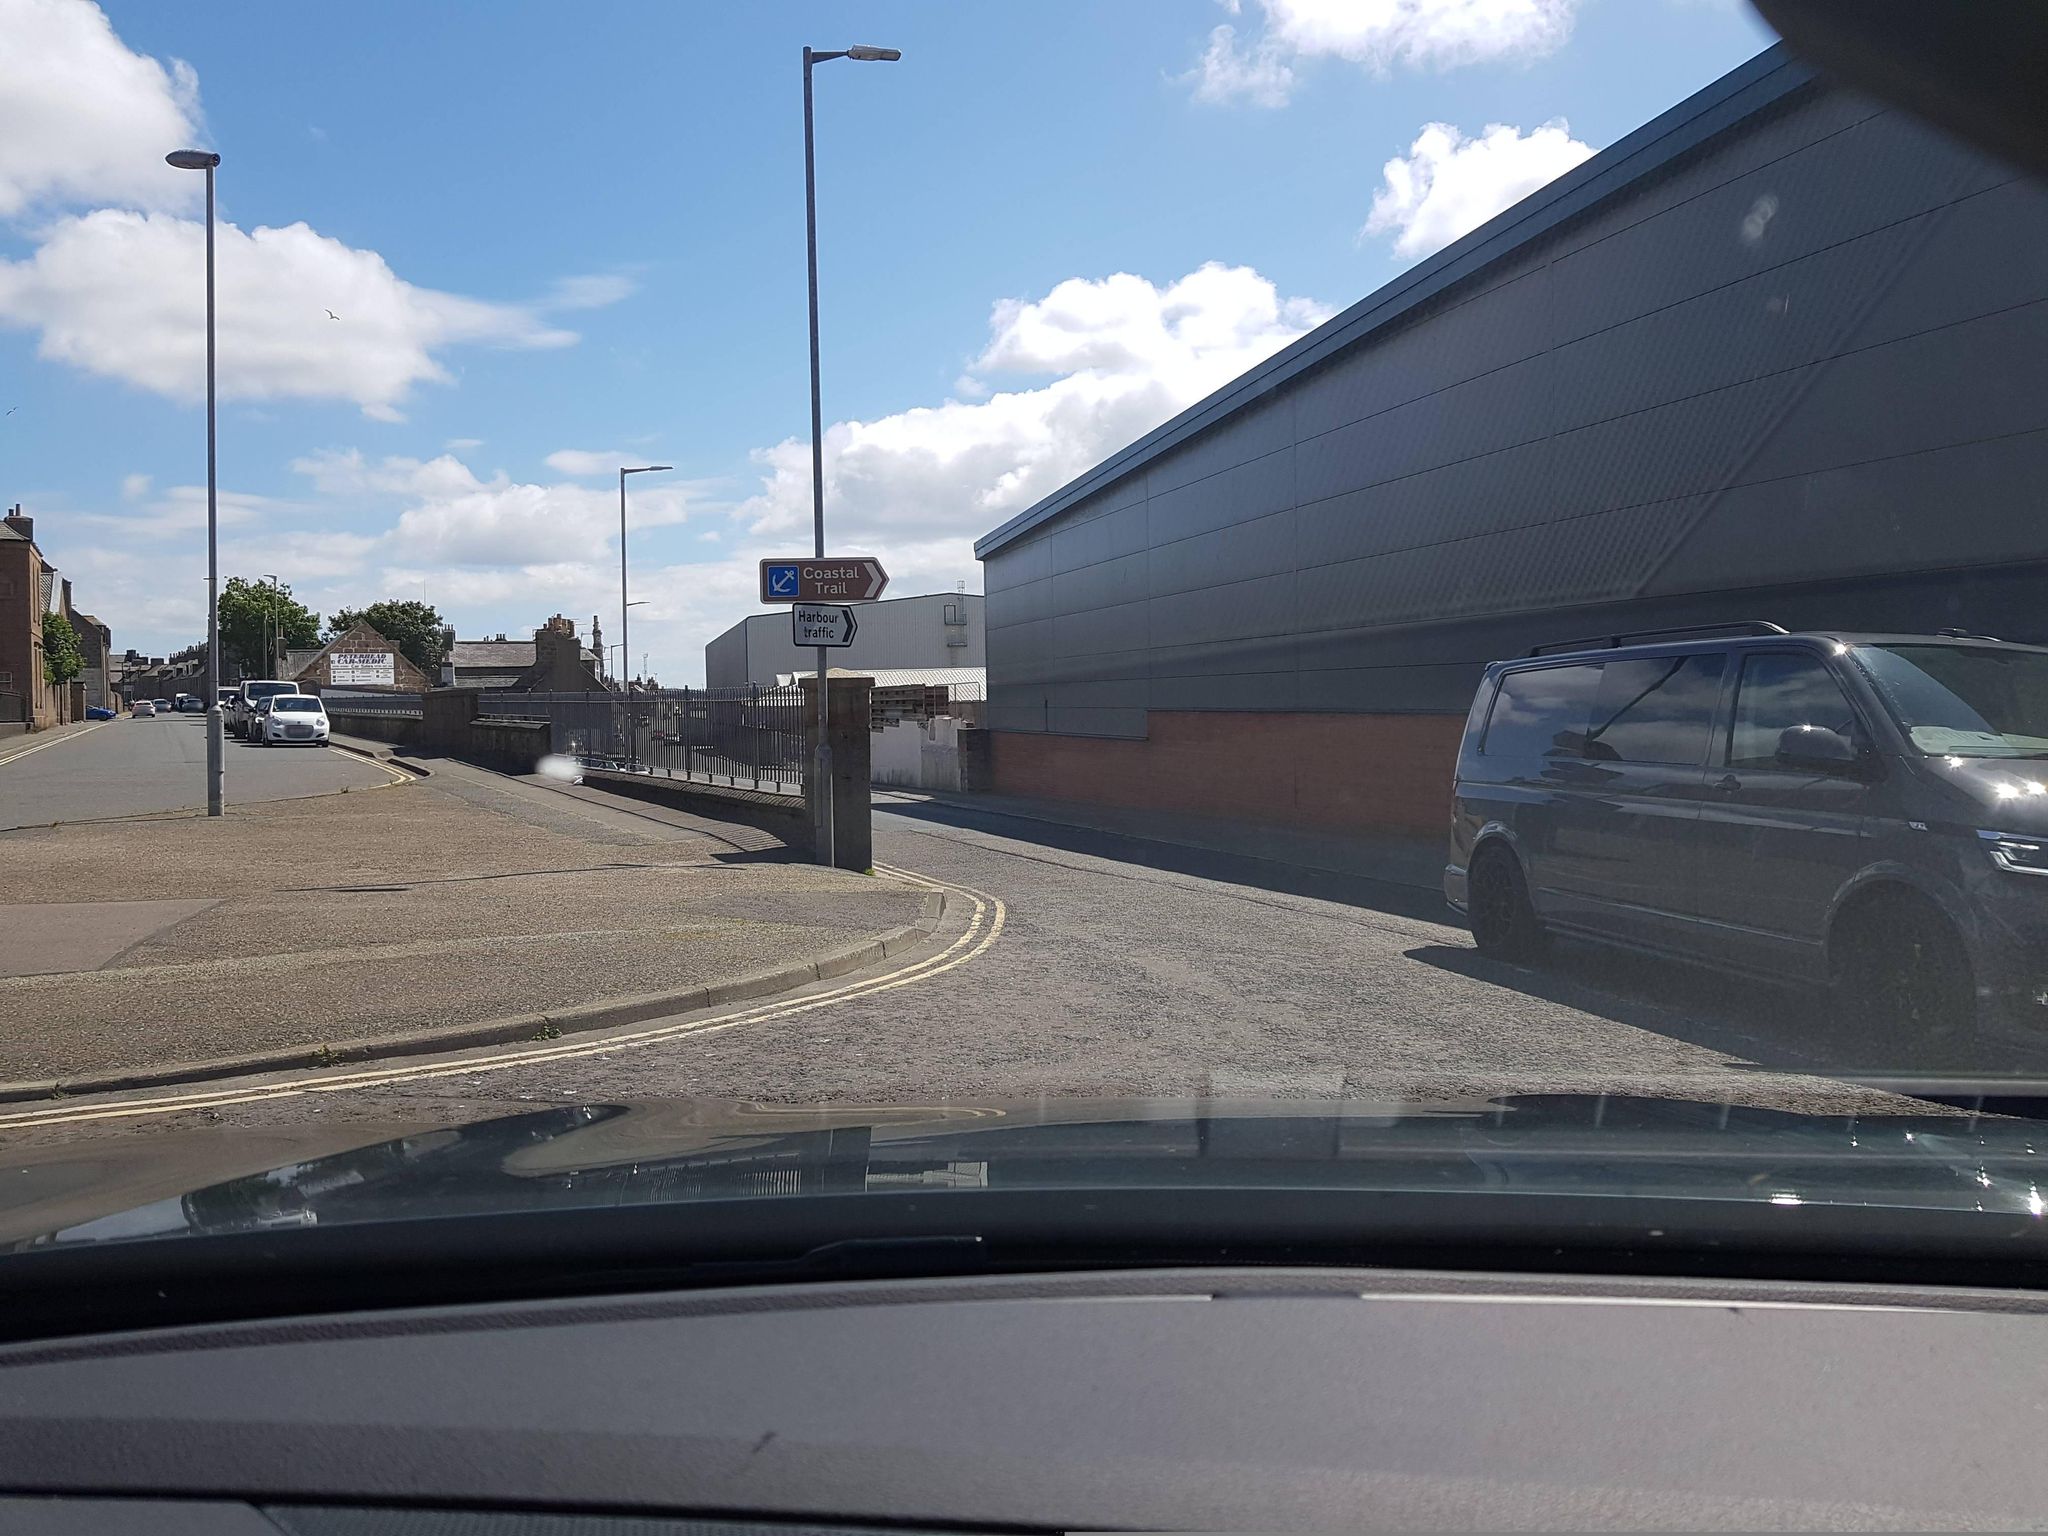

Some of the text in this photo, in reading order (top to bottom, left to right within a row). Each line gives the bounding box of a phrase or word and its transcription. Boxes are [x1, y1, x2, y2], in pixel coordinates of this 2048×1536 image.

[803, 566, 859, 580] Coastal
[815, 582, 848, 594] Trail
[798, 610, 839, 623] Harbour
[804, 626, 834, 638] traffic
